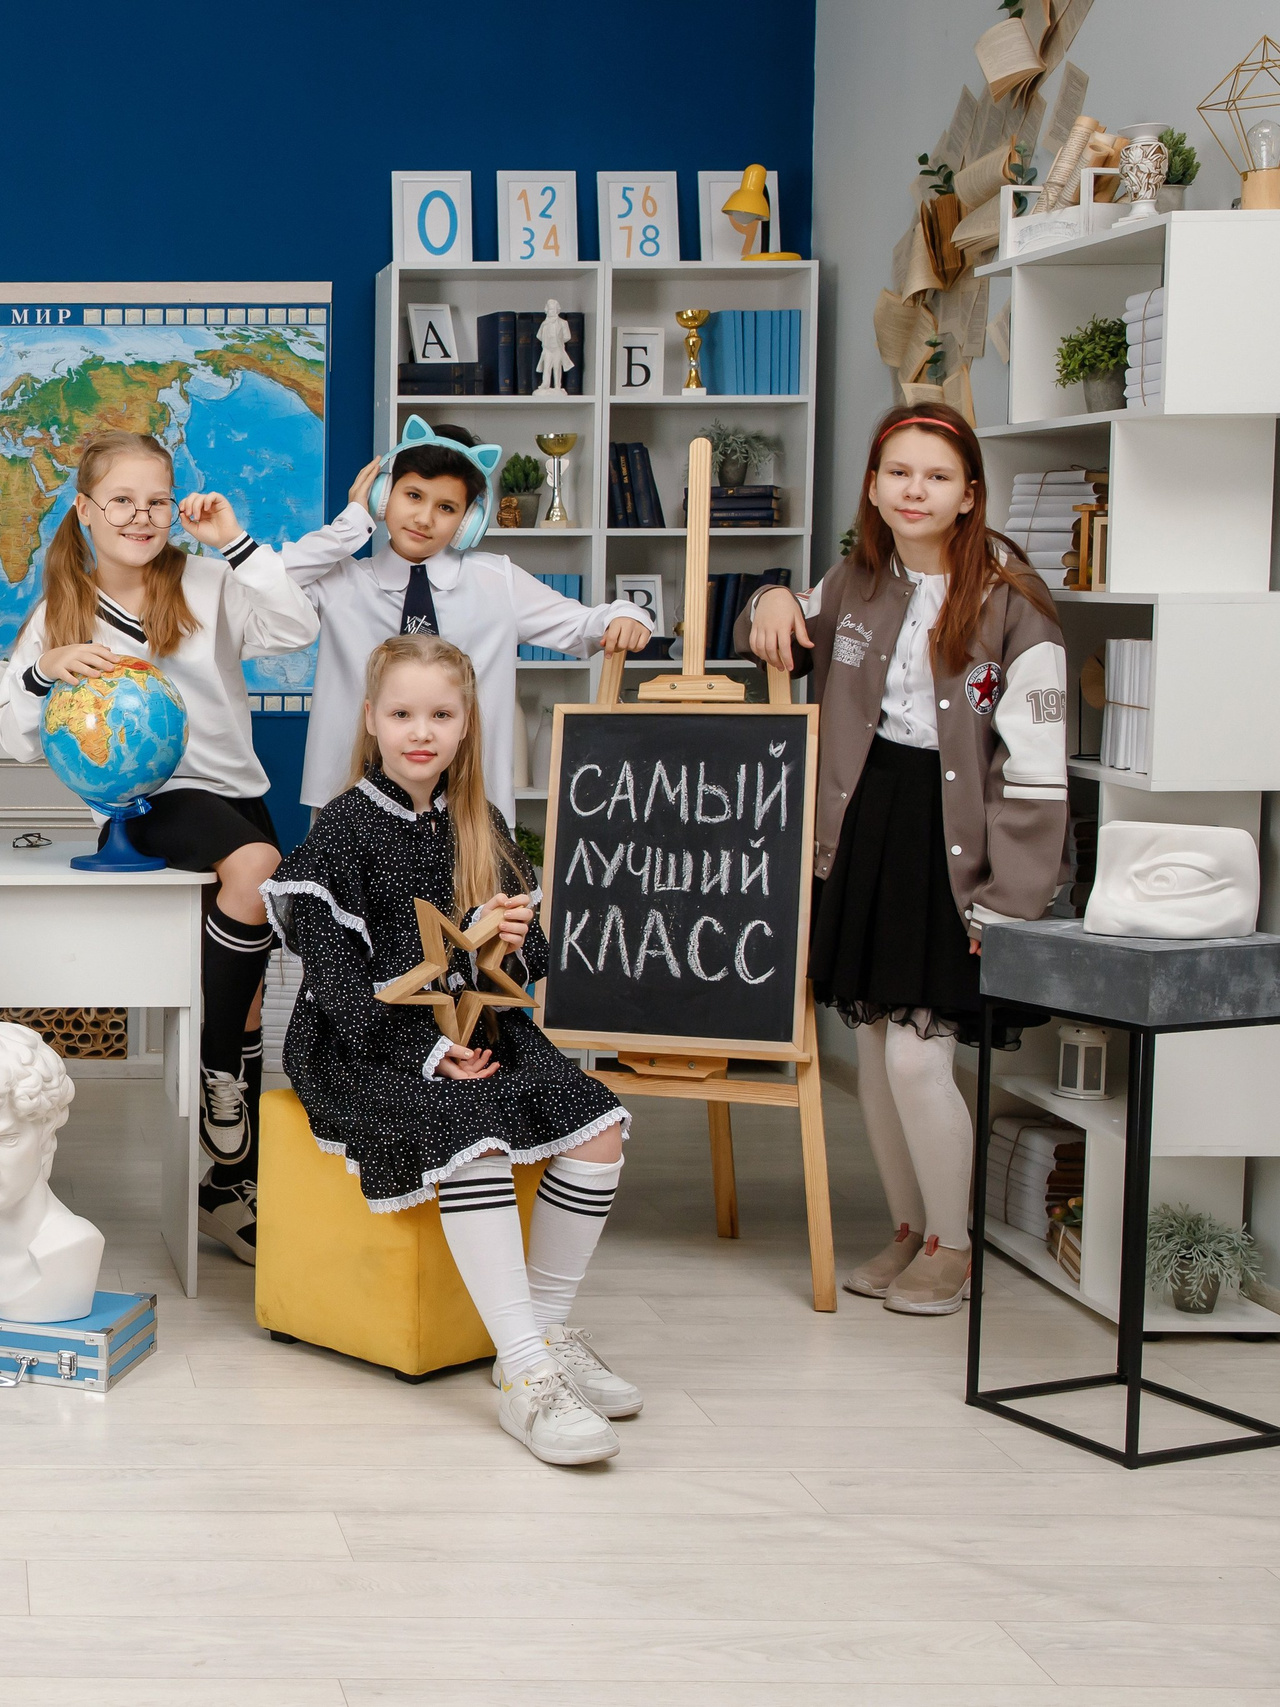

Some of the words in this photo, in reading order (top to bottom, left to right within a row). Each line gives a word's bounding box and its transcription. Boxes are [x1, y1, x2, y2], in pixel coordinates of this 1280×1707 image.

[11, 308, 72, 325] МИР
[422, 320, 452, 359] А
[621, 346, 651, 388] Б
[569, 740, 788, 832] САМЫЙ
[565, 836, 770, 896] ЛУЧШИЙ
[560, 904, 775, 985] КЛАСС
